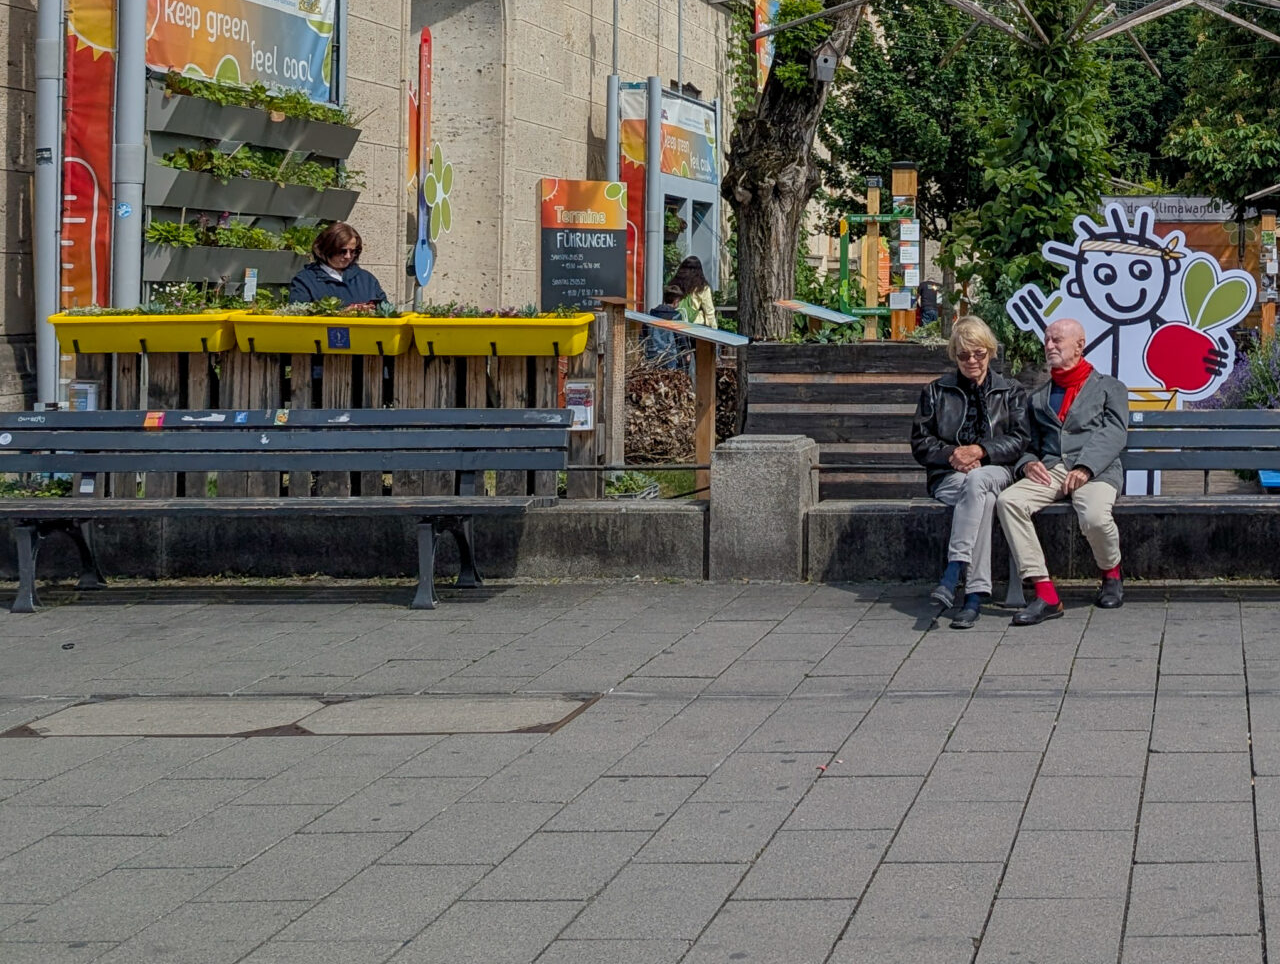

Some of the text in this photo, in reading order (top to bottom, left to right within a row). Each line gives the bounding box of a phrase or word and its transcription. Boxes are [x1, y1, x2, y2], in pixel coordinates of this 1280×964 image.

[206, 10, 250, 43] green
[250, 40, 314, 83] feel cool
[554, 205, 606, 225] Termine
[556, 230, 617, 250] FÜHRUNGEN:
